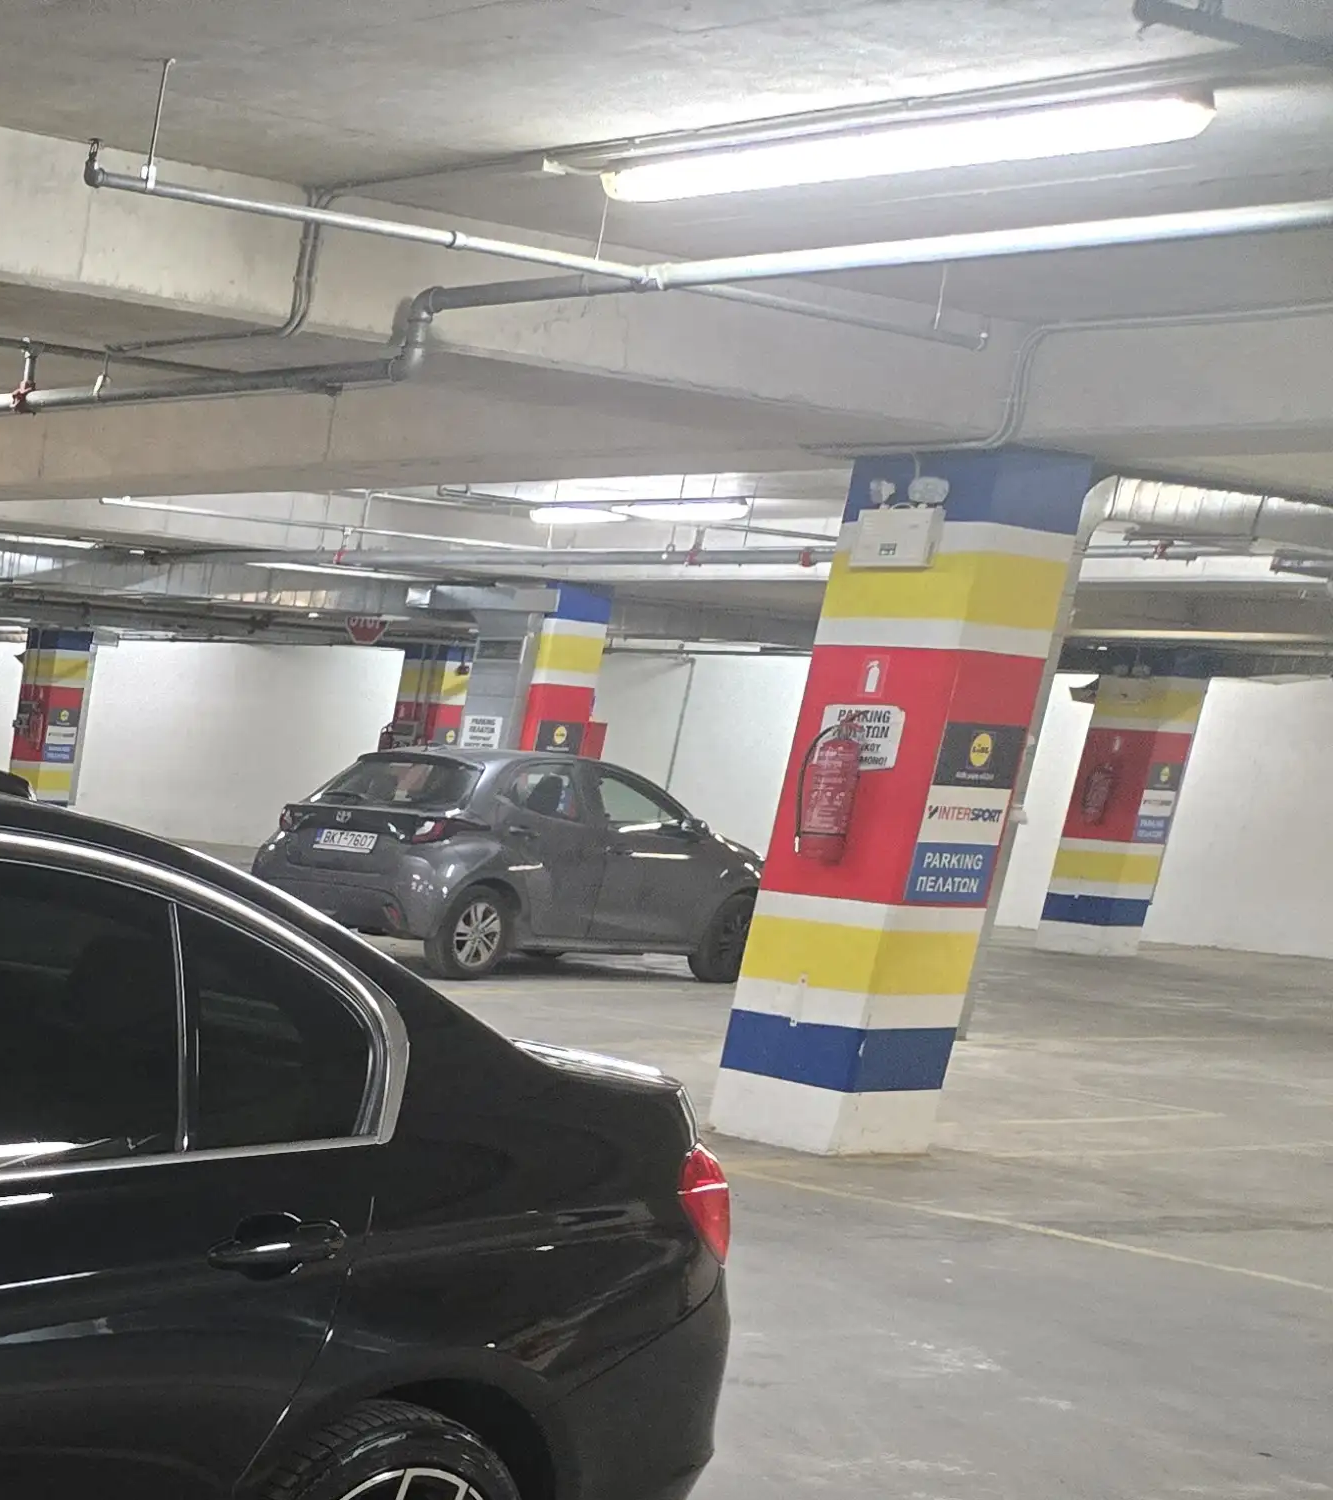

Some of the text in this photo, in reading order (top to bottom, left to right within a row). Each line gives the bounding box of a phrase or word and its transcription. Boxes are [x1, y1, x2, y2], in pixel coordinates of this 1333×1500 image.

[938, 805, 1003, 823] INTERSPORT
[923, 852, 983, 870] PARKING
[916, 876, 980, 894] ΠΕΛΑΤΩΝ
